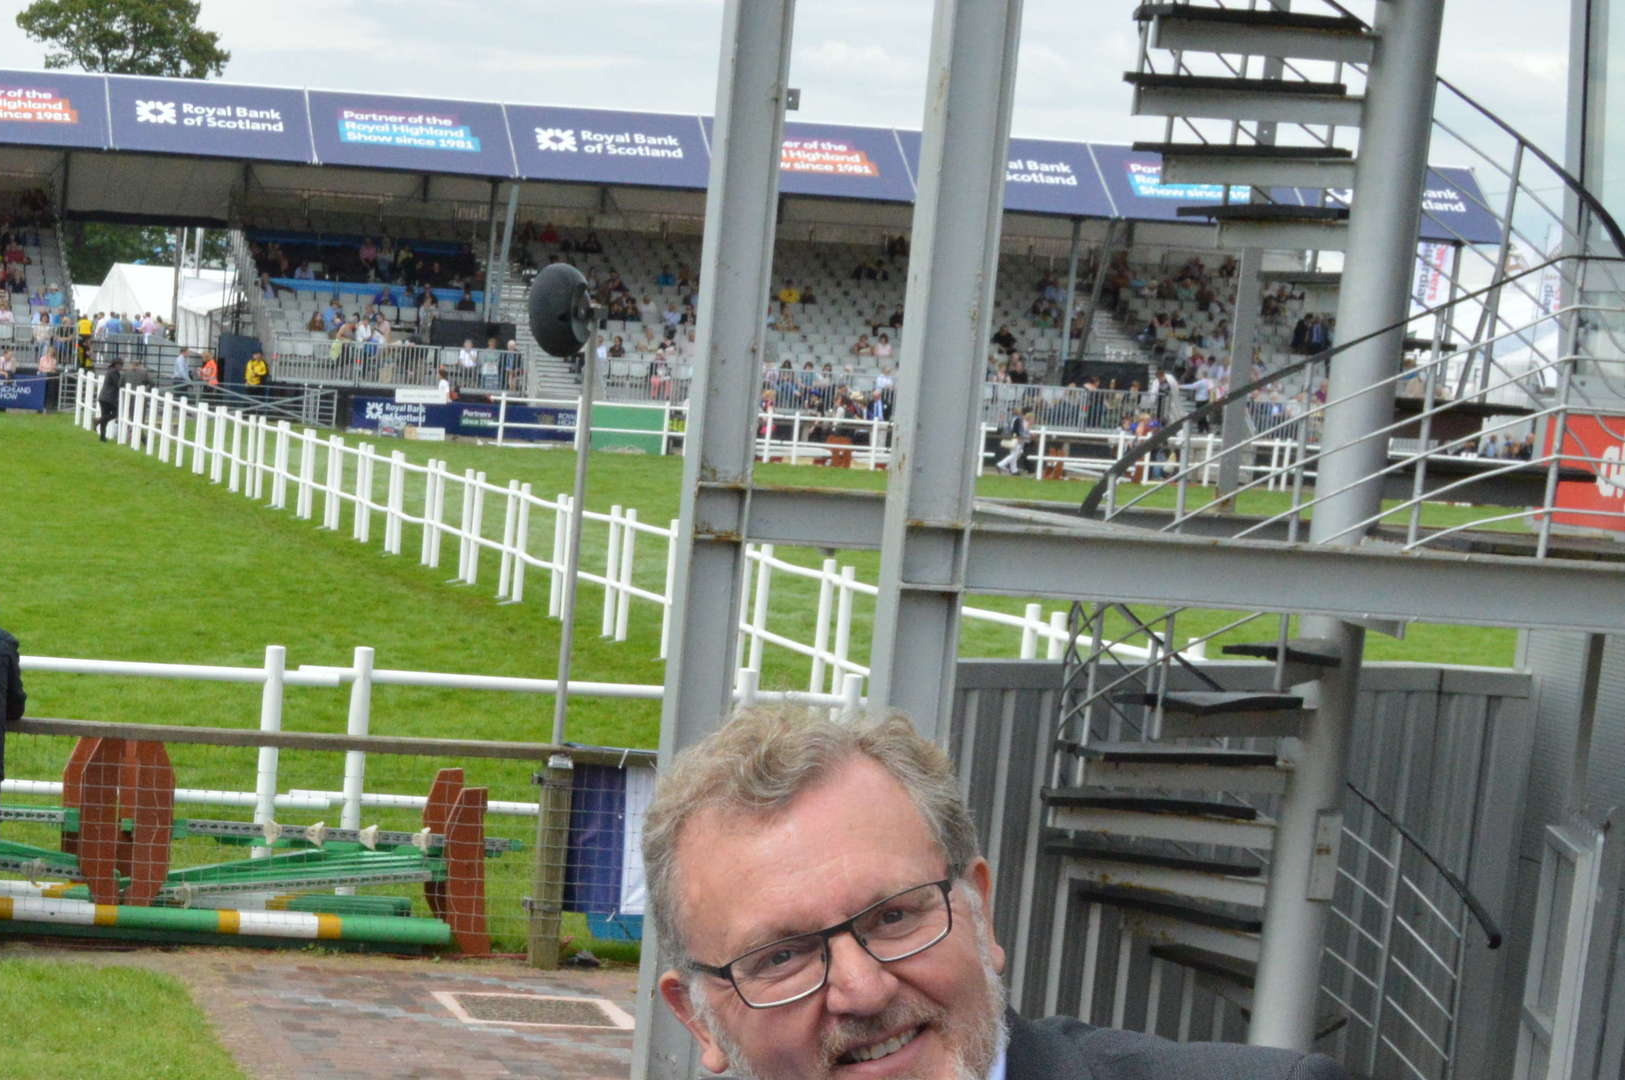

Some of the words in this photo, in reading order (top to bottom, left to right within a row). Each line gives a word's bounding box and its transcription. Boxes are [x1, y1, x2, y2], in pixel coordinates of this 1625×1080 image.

[7, 89, 24, 98] of
[25, 90, 52, 99] the
[36, 112, 72, 121] 1981
[183, 103, 232, 119] Royal
[236, 107, 281, 120] Bank
[343, 110, 406, 123] Partner
[408, 115, 426, 124] of
[426, 116, 453, 126] the
[183, 116, 207, 127] of
[207, 117, 284, 132] Scotland
[345, 121, 390, 133] Royal
[392, 124, 465, 138] Highland
[346, 132, 393, 143] Show
[395, 136, 436, 147] since
[439, 139, 474, 149] 1981
[580, 130, 631, 144] Royal
[634, 133, 679, 146] Bank
[584, 143, 607, 154] of
[607, 144, 683, 159] Scotland
[803, 141, 818, 149] of
[820, 141, 847, 151] the
[790, 150, 861, 163] Highland
[794, 162, 834, 172] since
[837, 164, 872, 174] 1981
[1026, 160, 1072, 173] Bank
[1138, 186, 1184, 197] Show
[1424, 189, 1459, 200] ank
[385, 403, 406, 413] Royal
